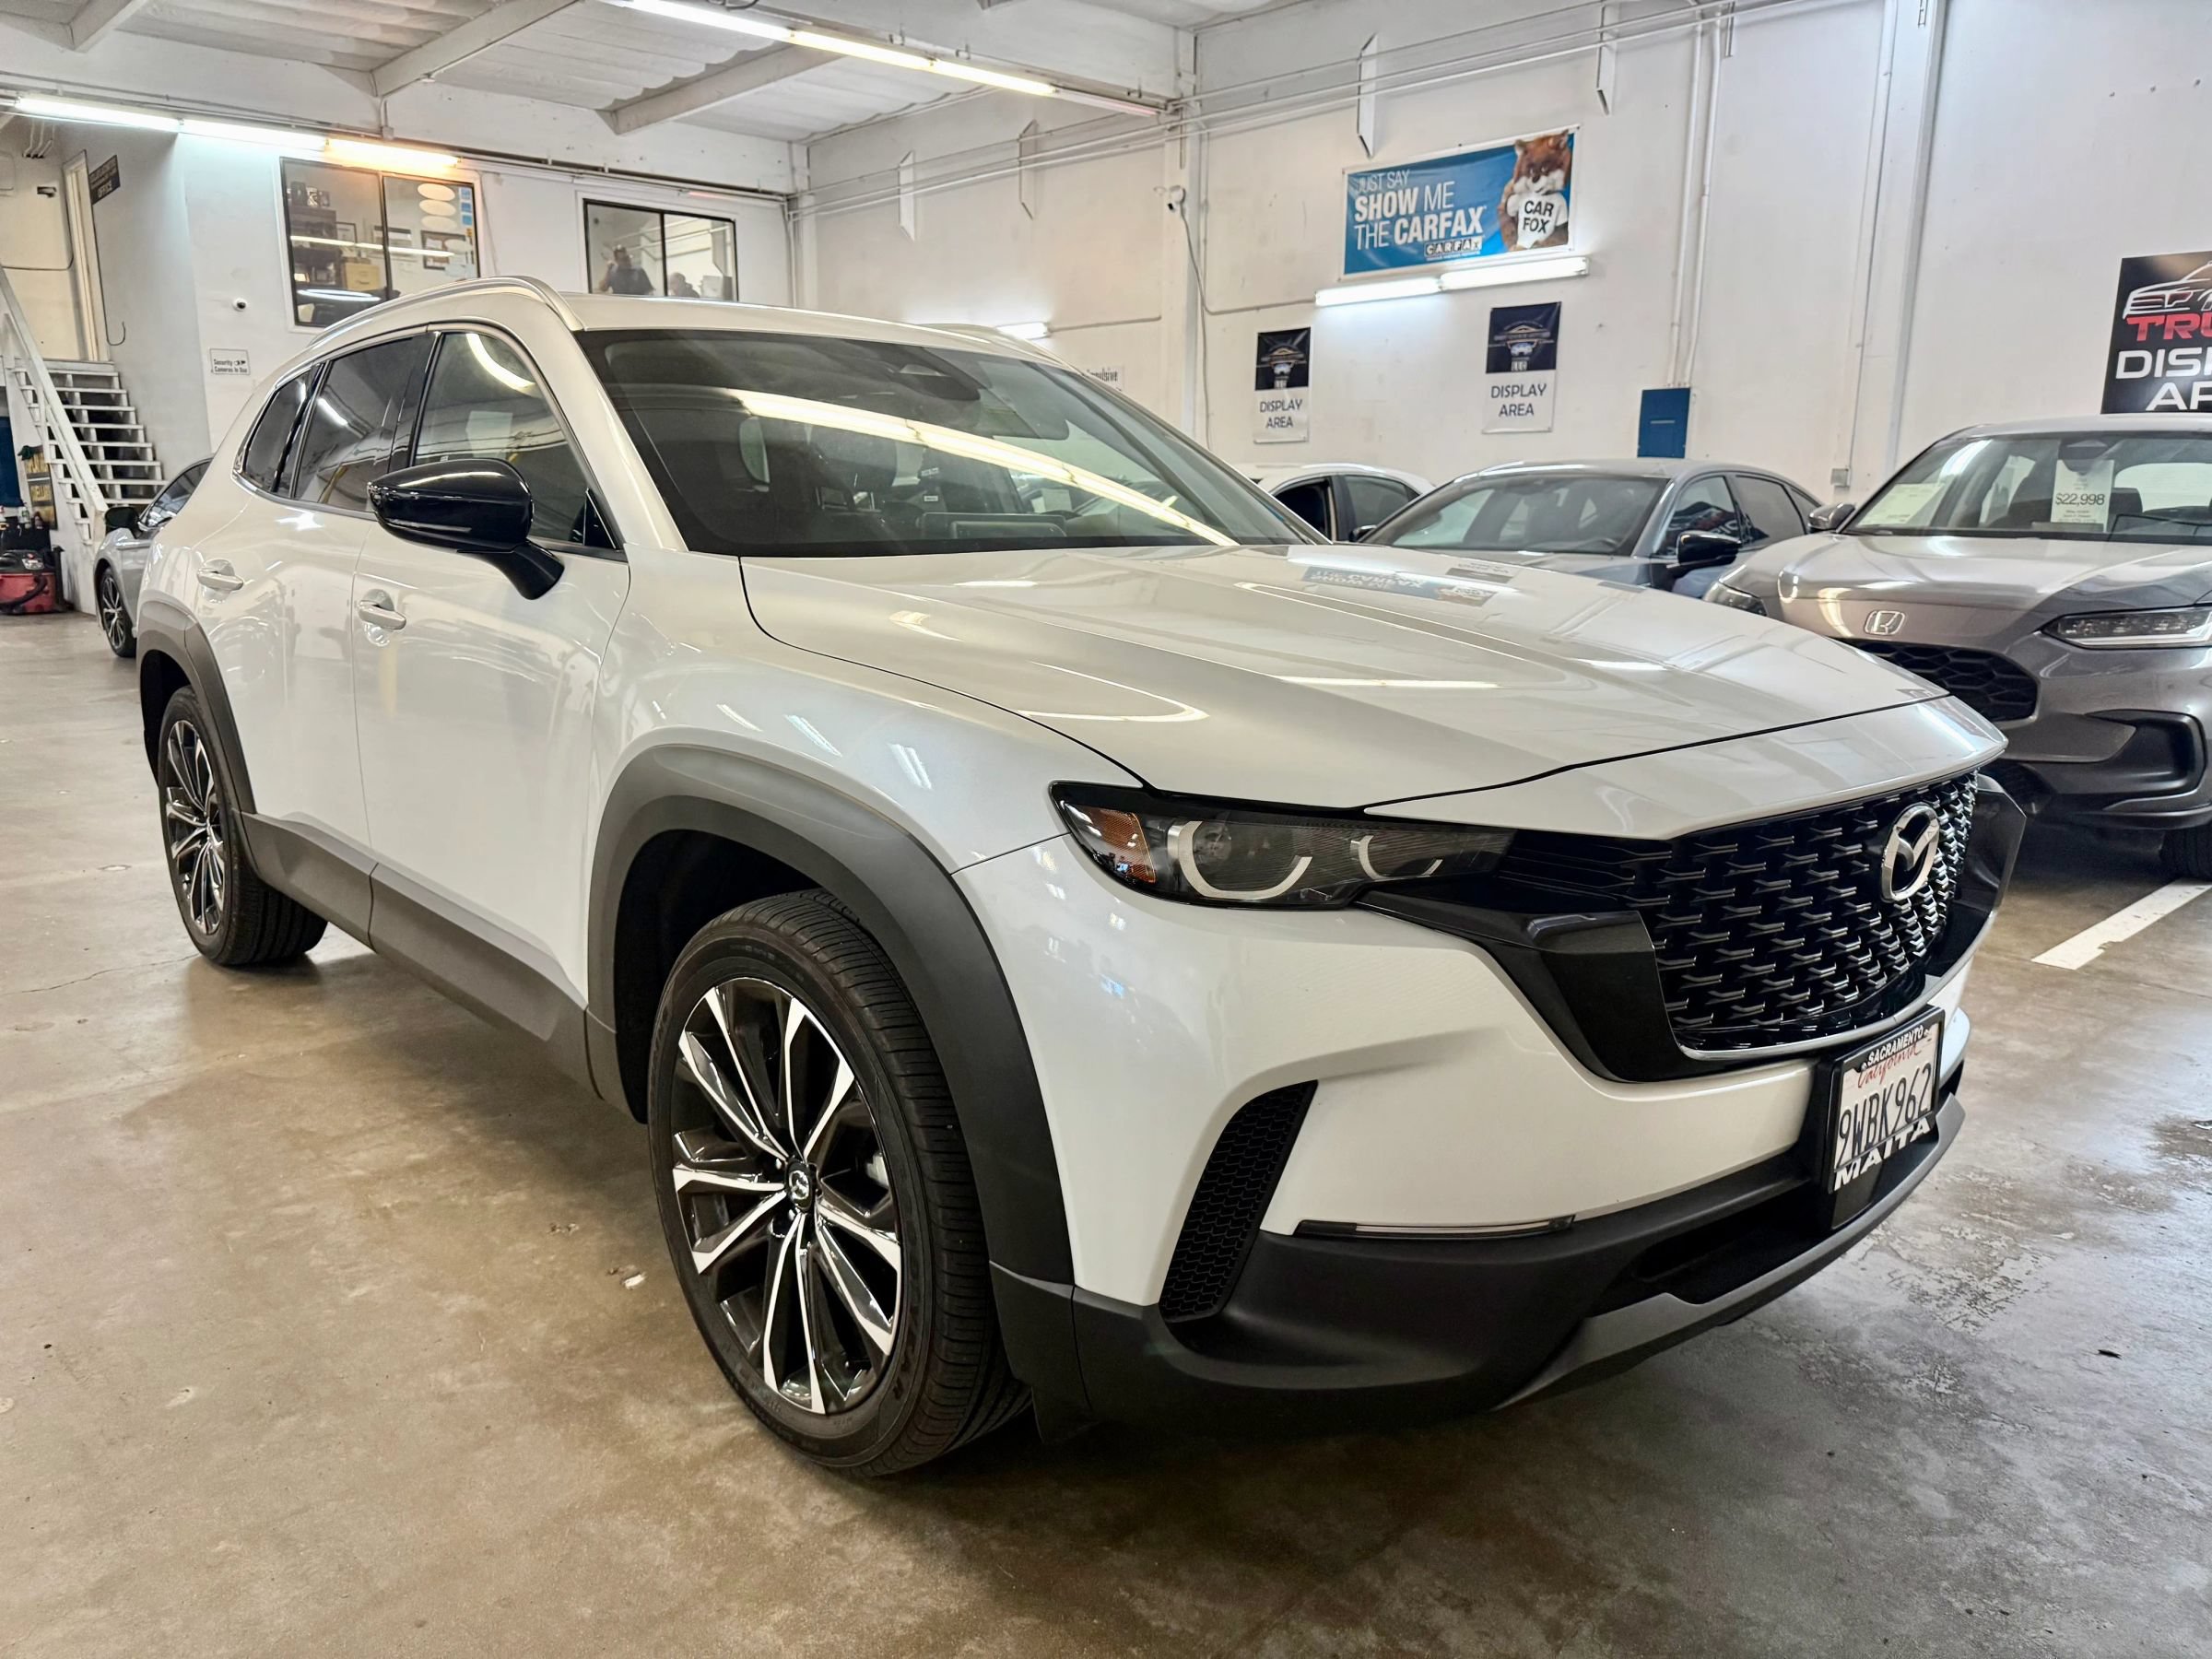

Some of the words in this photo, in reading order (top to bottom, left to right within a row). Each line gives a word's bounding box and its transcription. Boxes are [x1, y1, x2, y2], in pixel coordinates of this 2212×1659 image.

[1358, 173, 1385, 194] JUST
[1387, 170, 1410, 188] SAY
[1355, 187, 1418, 222] SHOW
[1424, 181, 1455, 211] ME
[1524, 200, 1554, 217] CAR
[1355, 219, 1391, 251] THE
[1394, 206, 1484, 245] CARFAX
[1523, 218, 1549, 233] FOX
[214, 359, 232, 367] Security
[2116, 347, 2212, 379] DIS
[1491, 383, 1547, 398] DISPLAY
[1260, 399, 1302, 413] DISPLAY
[1499, 403, 1535, 417] AREA
[1265, 417, 1293, 429] AREA
[2055, 492, 2106, 507] $22,998
[1867, 1026, 1923, 1065] SACRAMENTO
[1837, 1062, 1932, 1167] 9WBK962
[1834, 1117, 1930, 1191] MAITA
